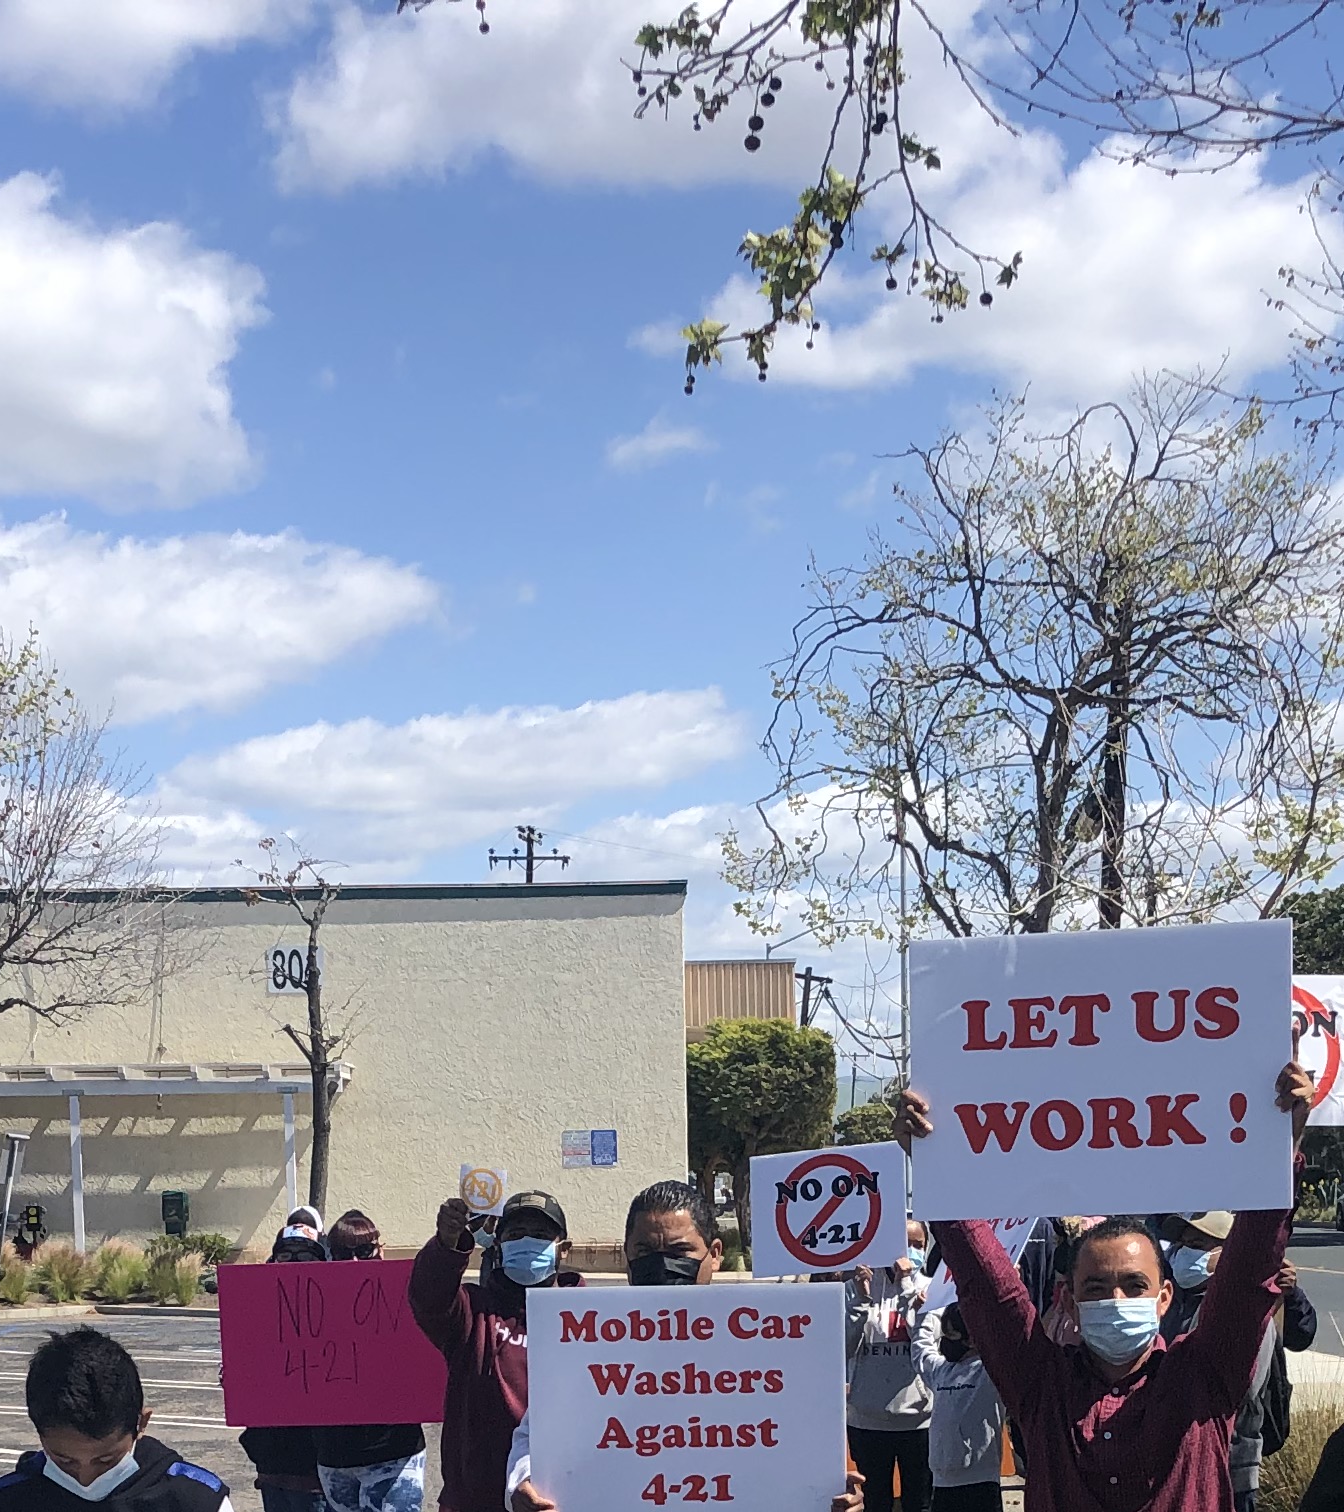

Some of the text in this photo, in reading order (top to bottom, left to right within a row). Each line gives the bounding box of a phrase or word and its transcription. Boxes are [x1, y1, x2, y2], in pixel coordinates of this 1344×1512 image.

[272, 949, 309, 989] 80
[961, 986, 1240, 1052] LET US
[954, 1093, 1207, 1154] WORK
[775, 1171, 880, 1204] NO ON
[801, 1222, 863, 1249] 4-21
[277, 1275, 410, 1343] NO ON
[559, 1307, 812, 1343] Mobile Car
[285, 1340, 358, 1394] 4-21
[587, 1363, 784, 1396] Washers
[596, 1416, 779, 1457] Against
[641, 1473, 735, 1506] 4-21
